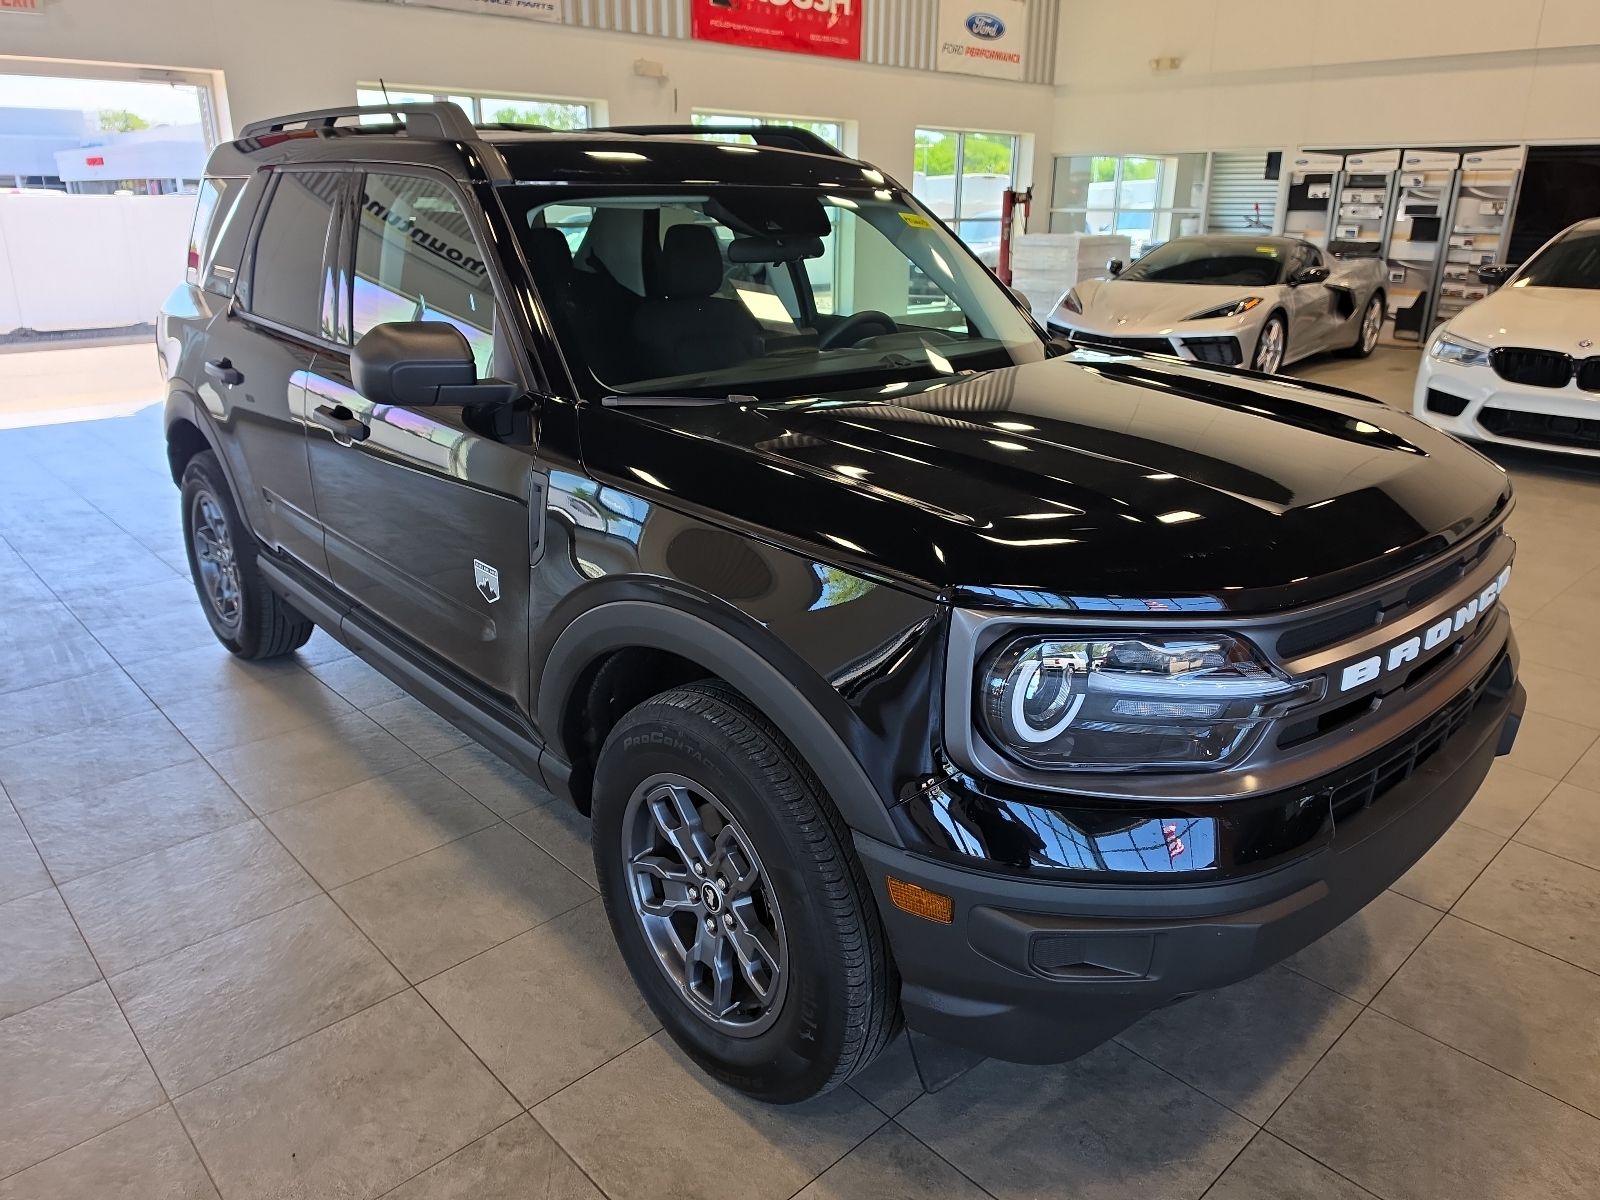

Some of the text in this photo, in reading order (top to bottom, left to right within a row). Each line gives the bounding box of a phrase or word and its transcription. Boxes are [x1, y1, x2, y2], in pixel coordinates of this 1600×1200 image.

[972, 16, 998, 37] Ford
[942, 43, 1020, 64] FORD PERFORMANCE
